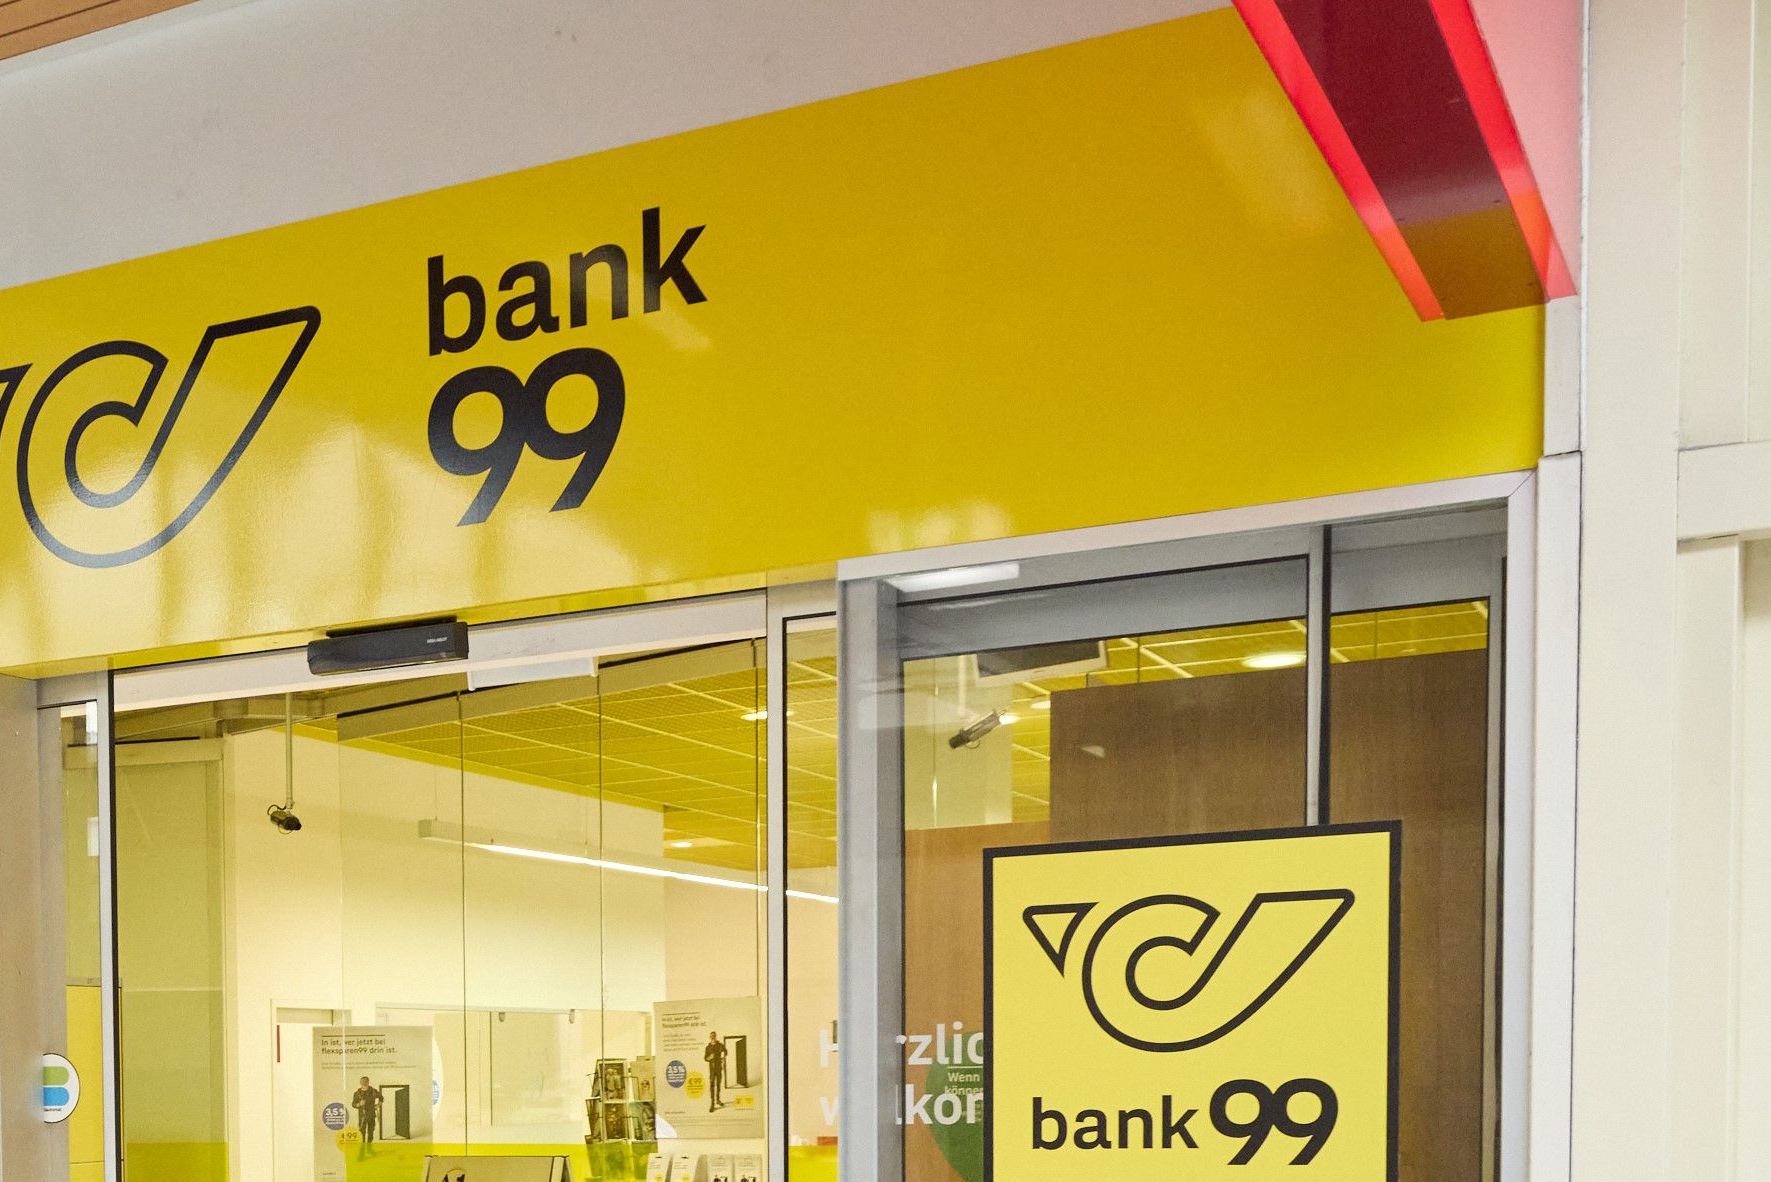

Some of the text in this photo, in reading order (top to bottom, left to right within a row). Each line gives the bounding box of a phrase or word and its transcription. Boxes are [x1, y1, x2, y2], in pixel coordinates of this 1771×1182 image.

[428, 206, 708, 357] bank
[428, 347, 626, 527] 99
[357, 1039, 373, 1047] jetzt
[948, 1072, 980, 1082] Wenn
[1032, 1078, 1339, 1166] bank 99
